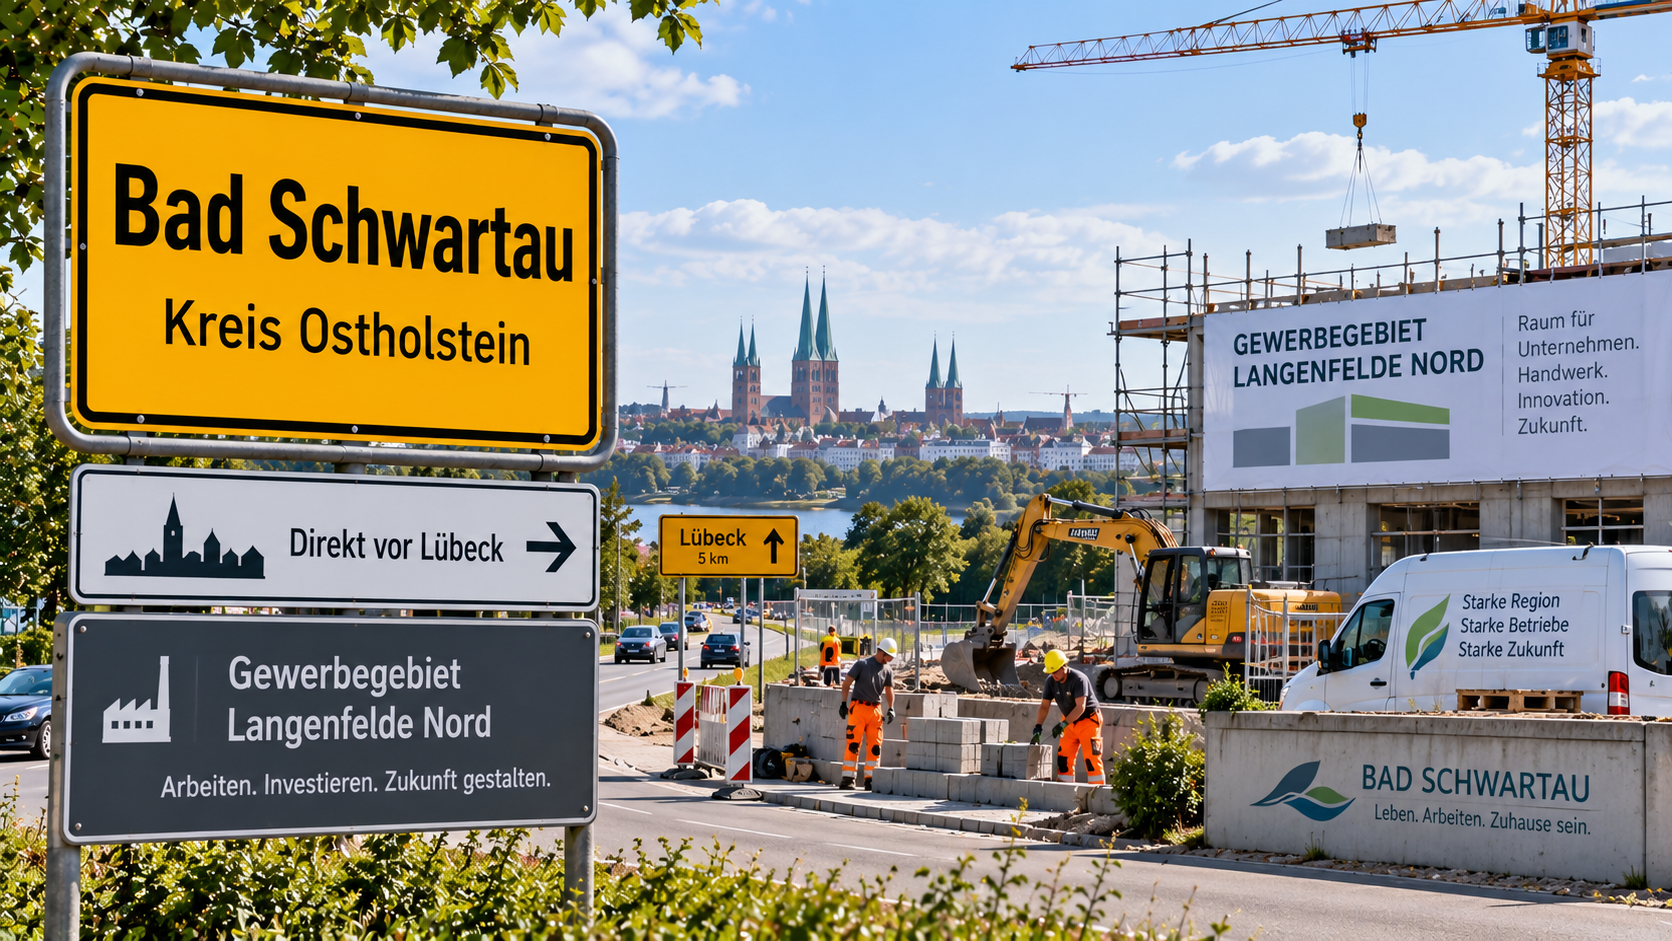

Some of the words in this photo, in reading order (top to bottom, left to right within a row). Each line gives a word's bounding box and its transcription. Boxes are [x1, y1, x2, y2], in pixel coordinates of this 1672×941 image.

[116, 163, 242, 254] Bad
[269, 179, 572, 282] Schwartau
[166, 298, 281, 351] Kreis
[301, 308, 529, 365] Ostholstein
[1519, 315, 1564, 331] Raum
[1571, 311, 1594, 327] für
[1234, 318, 1427, 355] GEWERBEGEBIET
[1519, 336, 1639, 357] Unternehmen.
[1234, 354, 1401, 388] LANGENFELDE
[1412, 349, 1483, 375] NORD
[1519, 362, 1607, 383] Handwerk.
[1519, 389, 1609, 408] Innovation.
[1518, 416, 1587, 434] Zukunft.
[291, 528, 365, 558] Direkt
[374, 538, 412, 559] vor
[422, 532, 503, 562] Lübeck
[681, 528, 746, 546] Lübeck
[699, 552, 705, 564] 5
[710, 552, 728, 564] km
[1463, 594, 1506, 609] Starke
[1511, 592, 1559, 612] Region
[1461, 617, 1504, 633] Starke
[1509, 616, 1569, 632] Betriebe
[1459, 641, 1502, 657] Starke
[1507, 640, 1564, 657] Zukunft
[230, 656, 460, 697] Gewerbegebiet
[229, 706, 413, 748] Langenfelde
[424, 705, 490, 737] Nord
[161, 775, 256, 797] Arbeiten.
[265, 772, 377, 794] Investieren.
[385, 769, 457, 791] Zukunft
[464, 767, 550, 794] gestalten.
[1363, 765, 1412, 791] BAD
[1422, 767, 1589, 802] SCHWARTAU
[1375, 804, 1418, 822] Leben.
[1423, 807, 1485, 827] Arbeiten.
[1491, 812, 1551, 832] Zuhause
[1557, 817, 1590, 834] sein.
